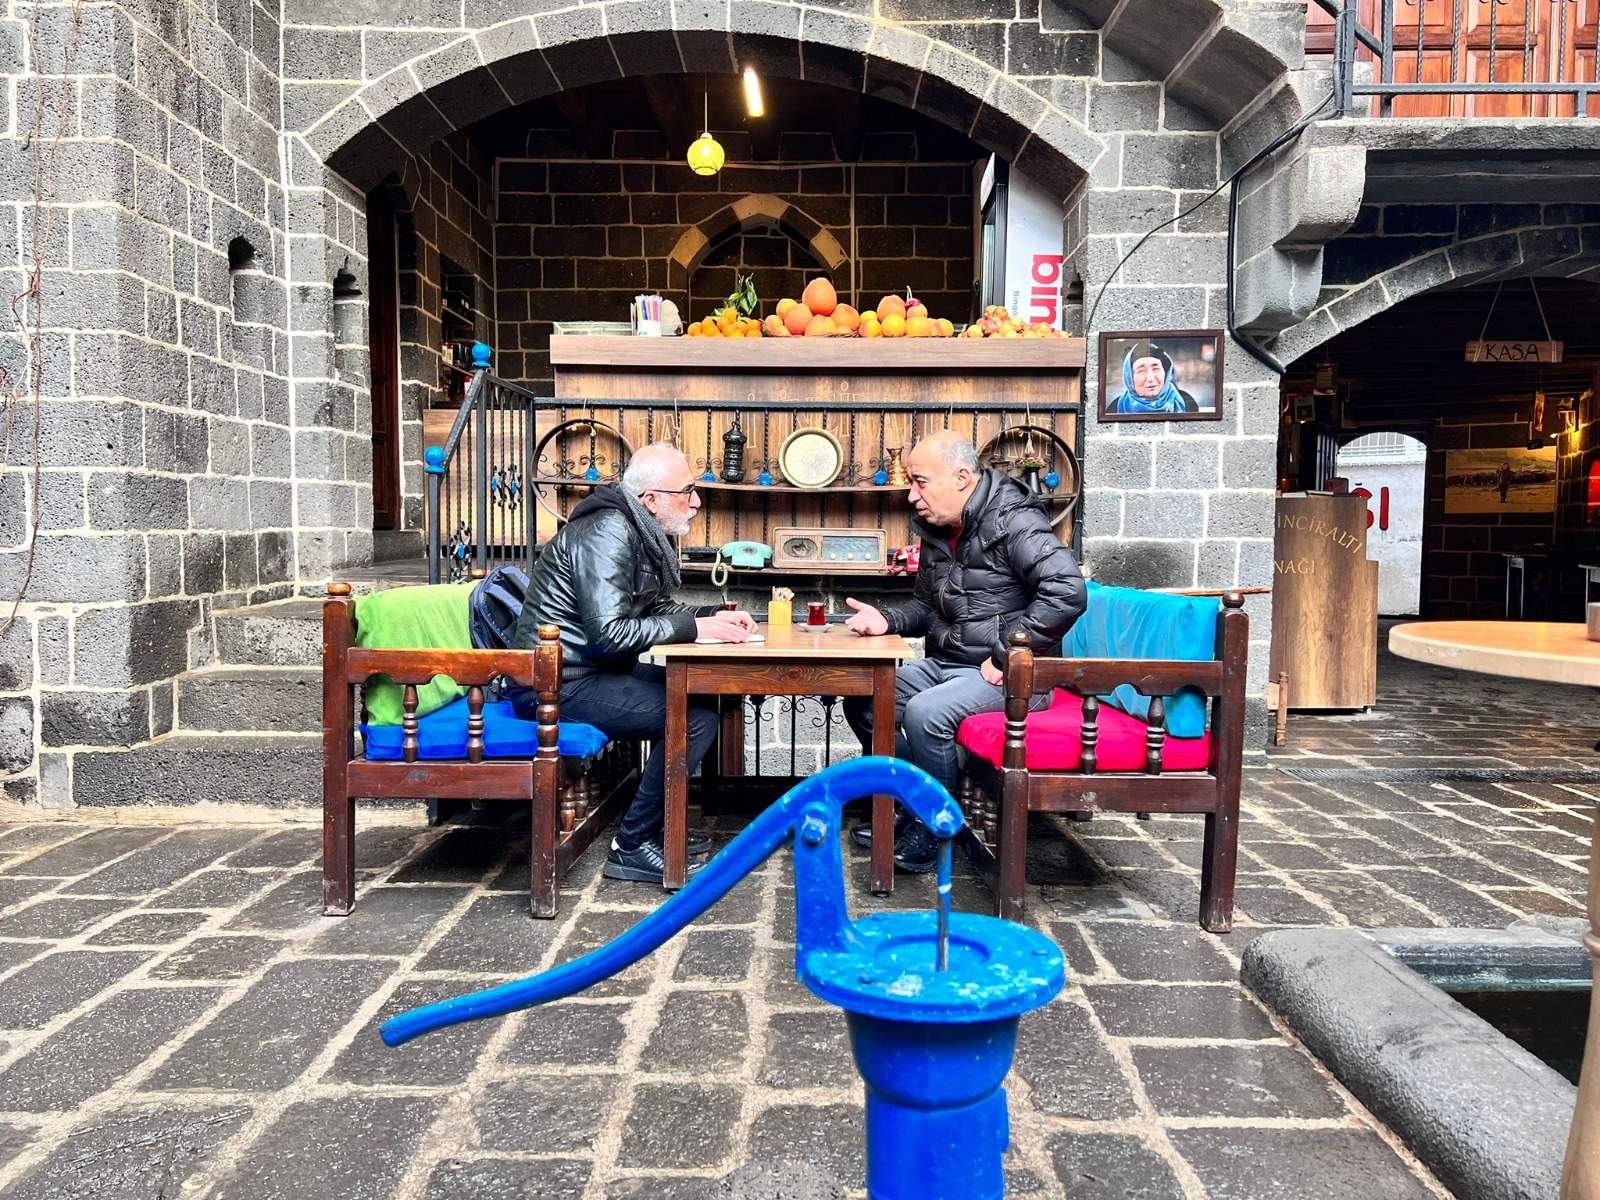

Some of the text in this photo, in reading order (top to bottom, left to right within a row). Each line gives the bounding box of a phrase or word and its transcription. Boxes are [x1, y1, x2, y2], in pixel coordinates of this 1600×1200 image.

[1029, 254, 1063, 332] bin
[1485, 343, 1540, 362] KASA
[1277, 513, 1363, 554] İNCİRALTI
